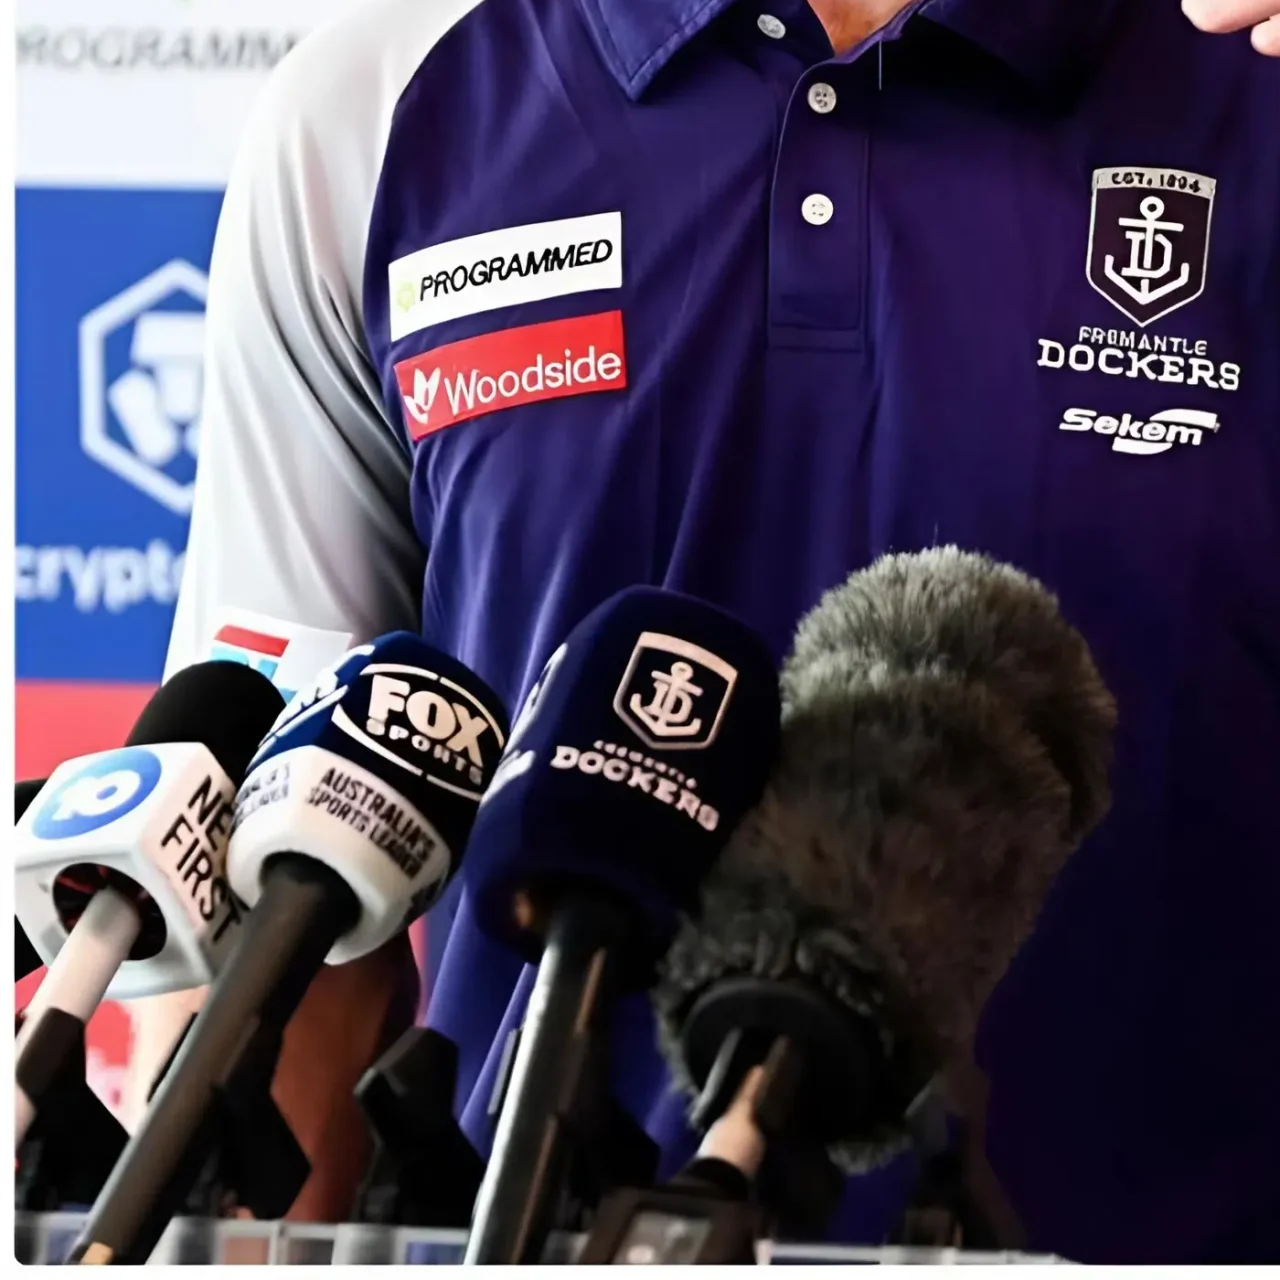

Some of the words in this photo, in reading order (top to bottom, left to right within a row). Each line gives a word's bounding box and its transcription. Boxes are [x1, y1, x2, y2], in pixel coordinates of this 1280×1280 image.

[420, 239, 613, 301] PROGRAMMED
[444, 345, 622, 415] Woodside
[1037, 338, 1241, 391] DOCKERS
[366, 716, 484, 786] SPORTS
[367, 674, 490, 768] FOX
[305, 787, 368, 834] SPORTS
[550, 745, 720, 832] DOCKERS
[161, 813, 242, 946] FIRST
